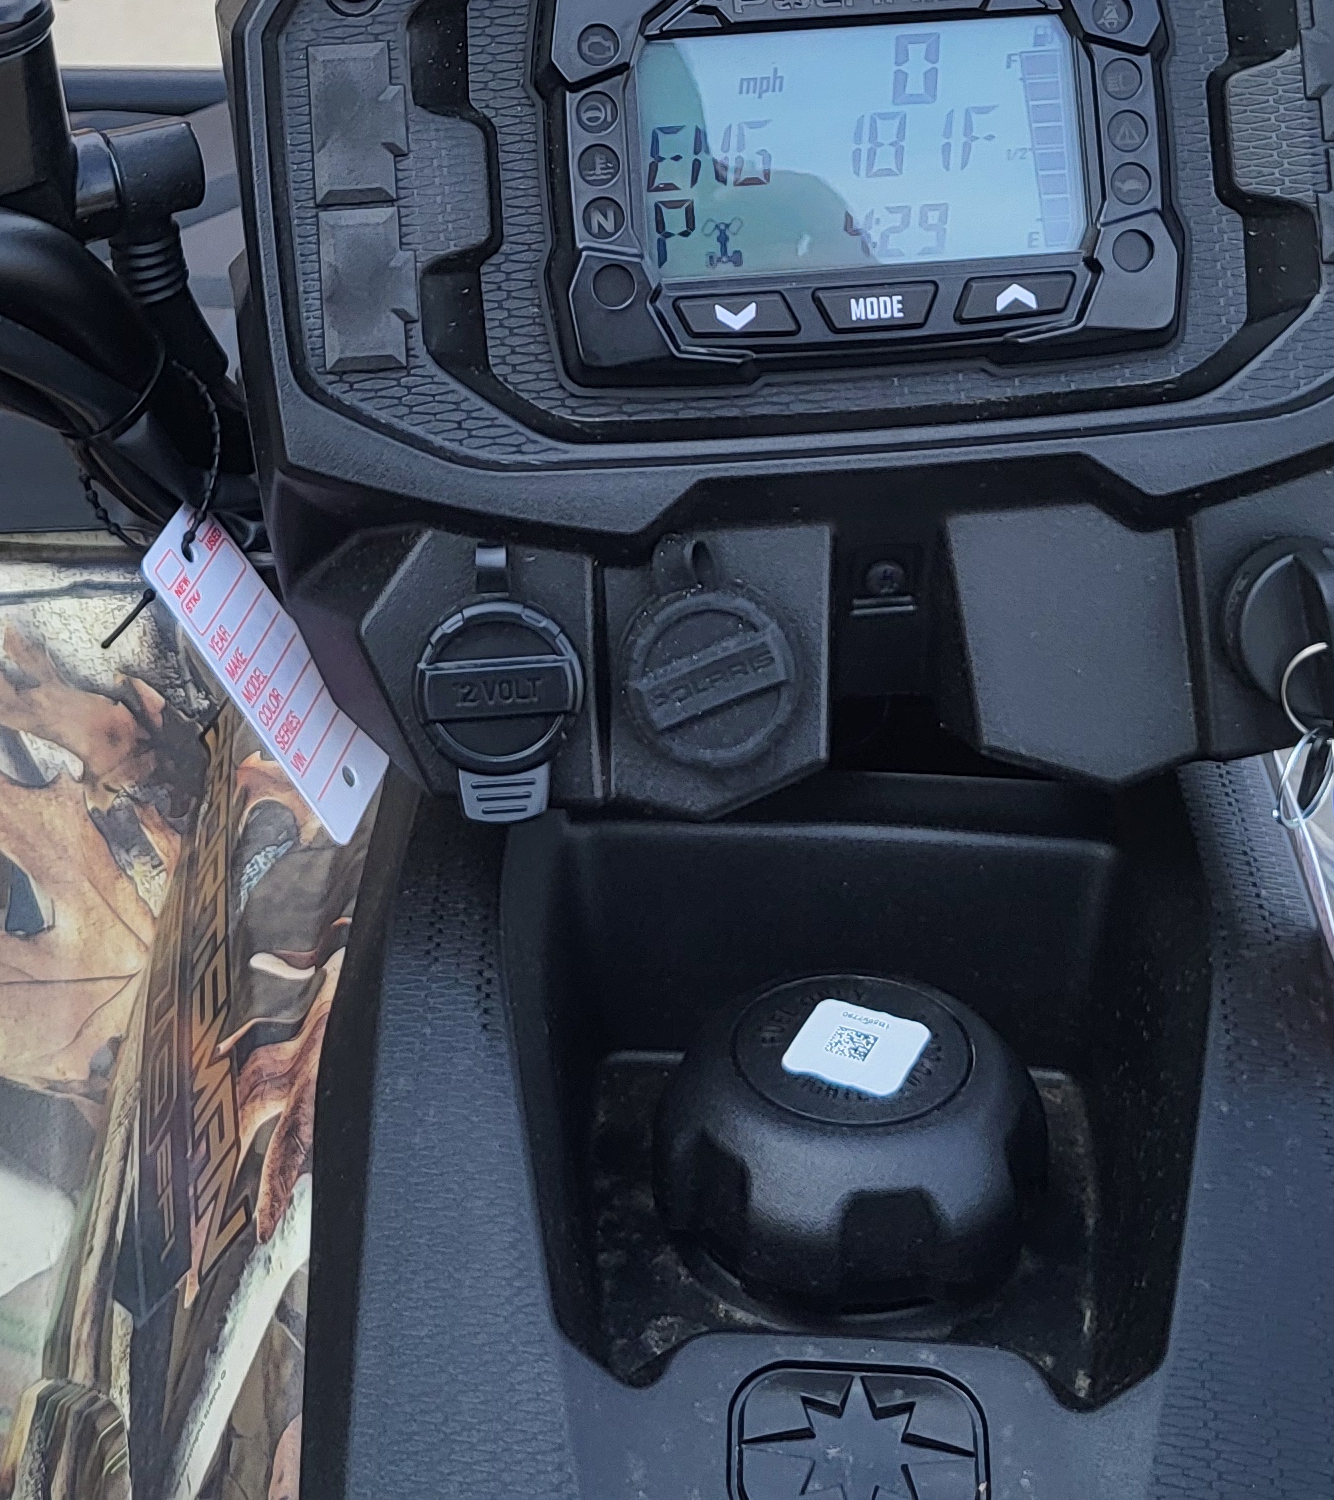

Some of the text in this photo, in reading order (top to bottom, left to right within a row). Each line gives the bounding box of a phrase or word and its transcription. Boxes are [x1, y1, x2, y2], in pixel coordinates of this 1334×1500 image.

[738, 68, 784, 98] mph
[648, 120, 773, 193] ENG
[656, 199, 696, 269] P
[849, 296, 905, 321] MODE
[205, 526, 222, 551] USED
[174, 574, 191, 599] NEW
[209, 624, 232, 654] YEAR
[224, 647, 248, 681] MAKE
[241, 667, 269, 704] MODEL
[258, 688, 285, 726] COLOR
[291, 752, 307, 772] VIN
